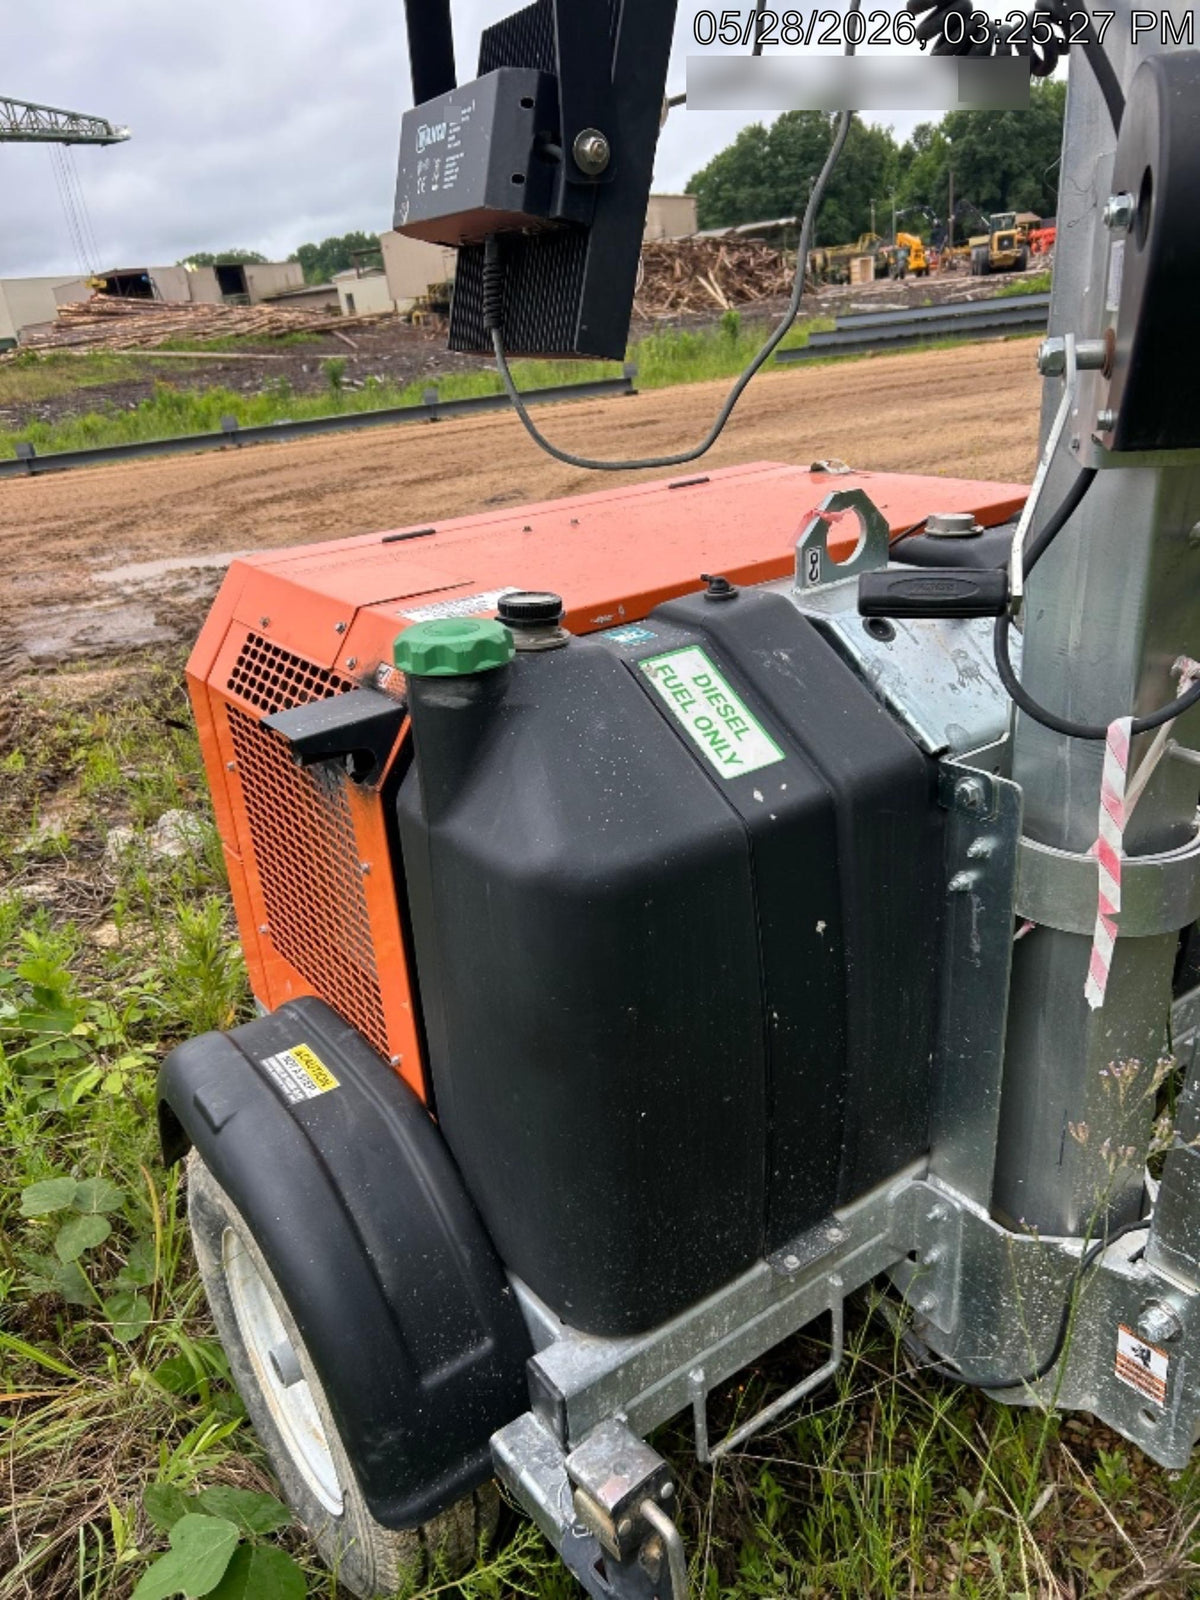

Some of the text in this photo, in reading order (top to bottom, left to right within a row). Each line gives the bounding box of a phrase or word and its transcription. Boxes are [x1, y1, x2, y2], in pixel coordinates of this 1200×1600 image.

[656, 664, 744, 765] FUEL ONLY
[692, 673, 750, 741] DIESEL
[300, 1053, 333, 1087] CAUTION
